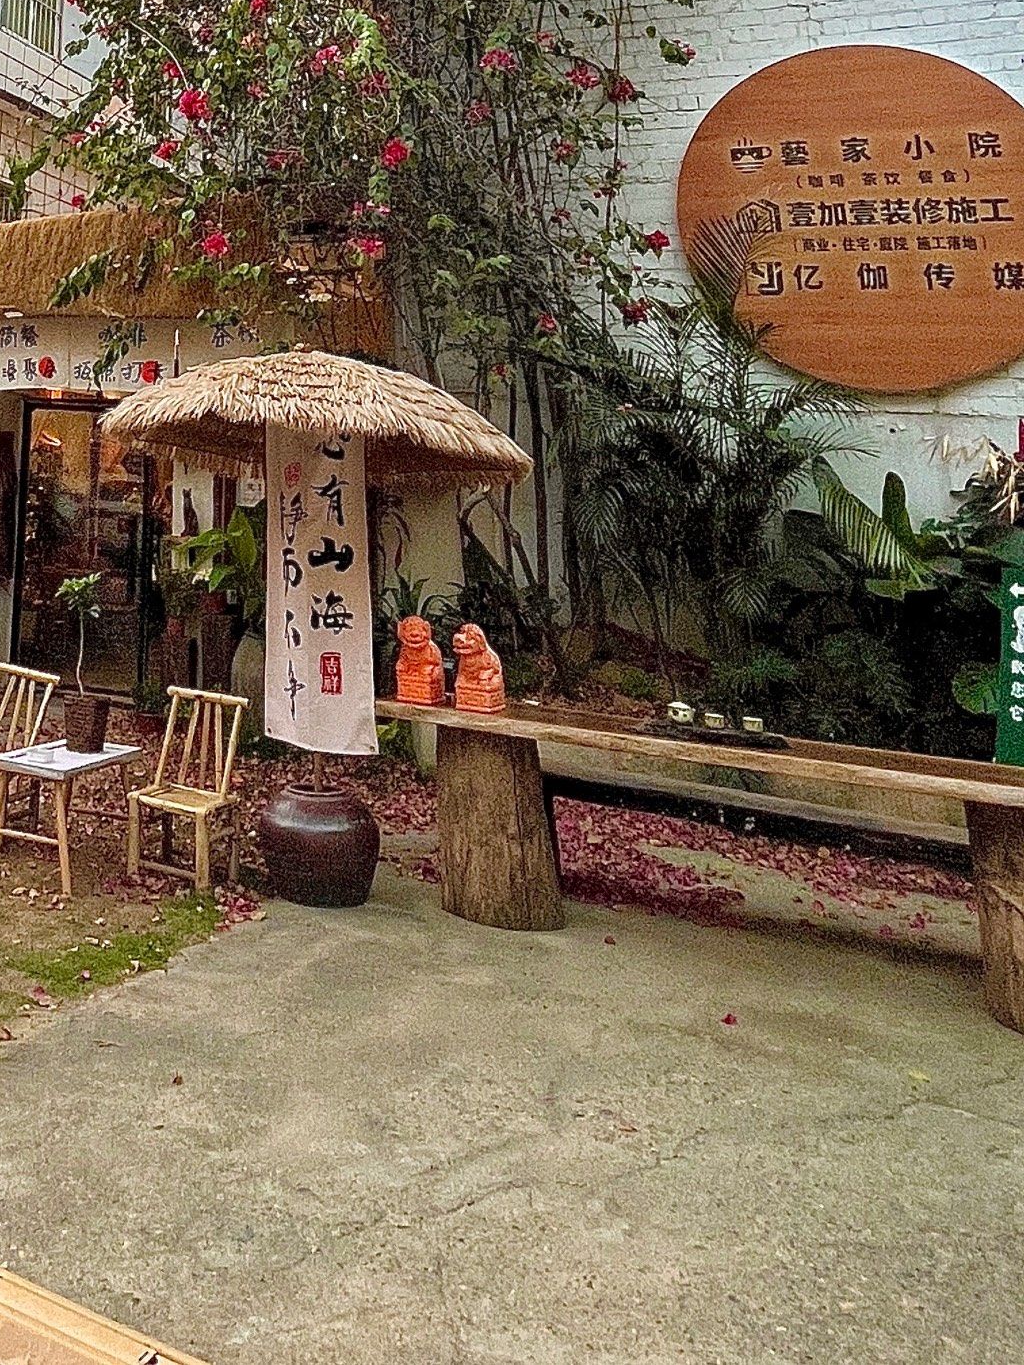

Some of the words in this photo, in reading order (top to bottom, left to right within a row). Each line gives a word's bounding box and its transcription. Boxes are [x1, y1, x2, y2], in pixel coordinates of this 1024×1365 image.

[786, 196, 1015, 227] 壹加壹装修施工
